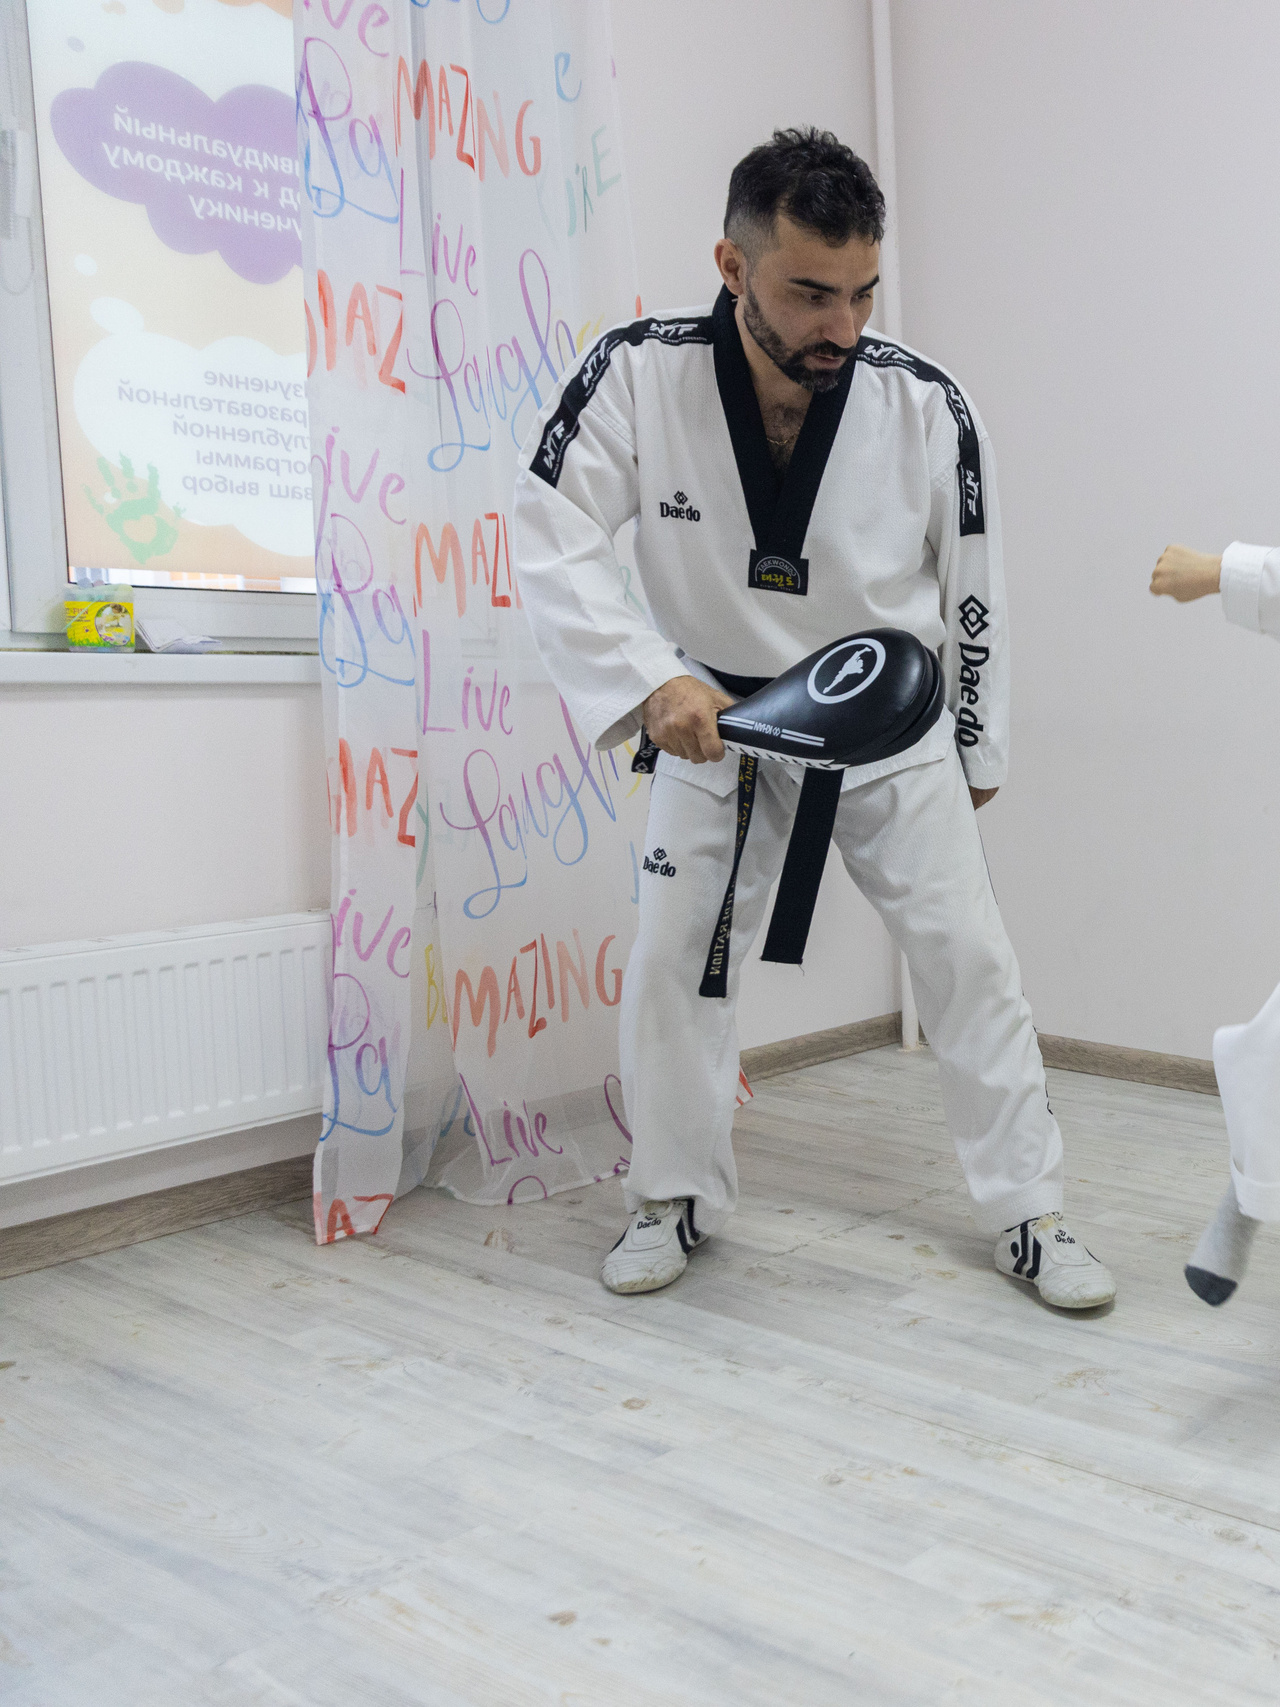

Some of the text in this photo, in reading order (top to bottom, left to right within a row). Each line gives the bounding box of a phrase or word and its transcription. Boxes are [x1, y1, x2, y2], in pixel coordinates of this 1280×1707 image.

[400, 168, 479, 296] Live
[659, 502, 700, 522] Daedo
[421, 629, 513, 735] Live
[958, 642, 990, 748] Daedo
[643, 855, 677, 878] Daedo
[459, 1072, 563, 1167] Live
